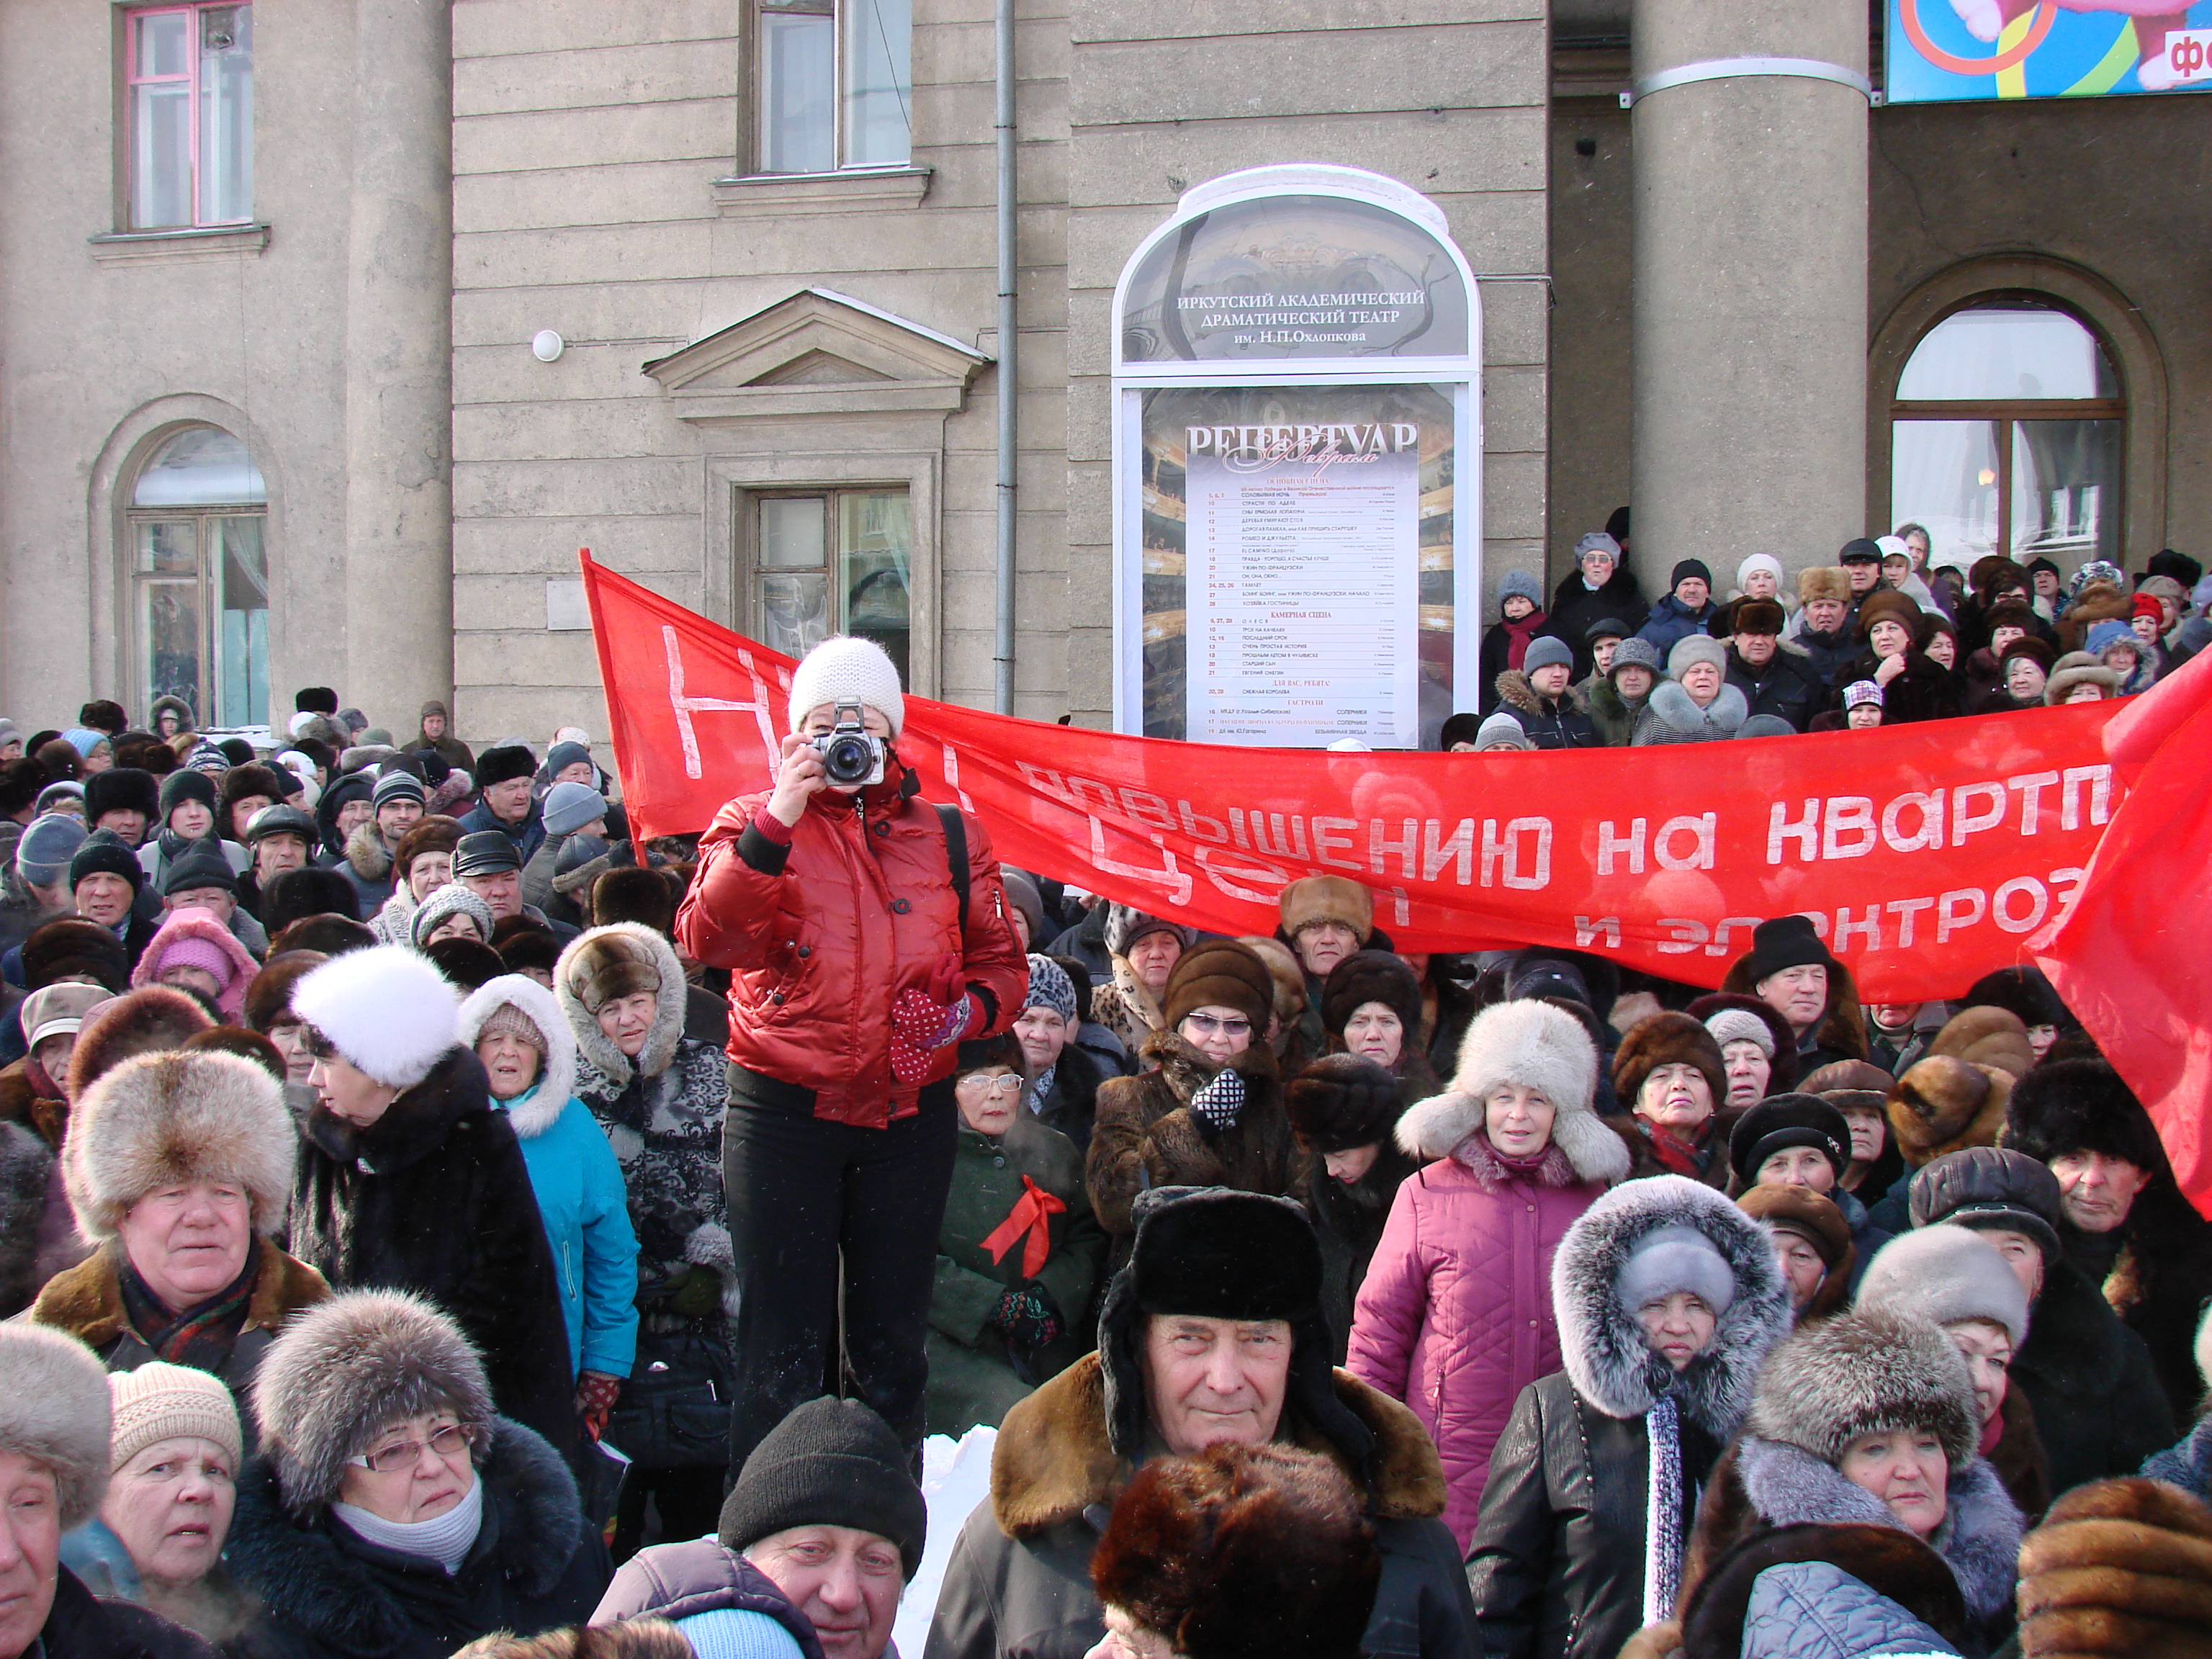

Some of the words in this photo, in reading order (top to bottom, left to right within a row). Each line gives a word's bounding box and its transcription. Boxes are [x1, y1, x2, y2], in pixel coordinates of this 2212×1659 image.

[2171, 36, 2212, 78] ф
[1177, 293, 1274, 310] ИРКУТСКИЙ
[1278, 290, 1425, 308] АКАДЕМИЧЕСКИЙ
[1201, 310, 1345, 328] ДРАМАТИЧЕСКИЙ
[1349, 311, 1400, 323] ТЕАТР
[1234, 334, 1256, 344] им.
[1259, 331, 1366, 343] Н.П.Охлопкова
[1187, 424, 1418, 457] РЕПЕРТУАР
